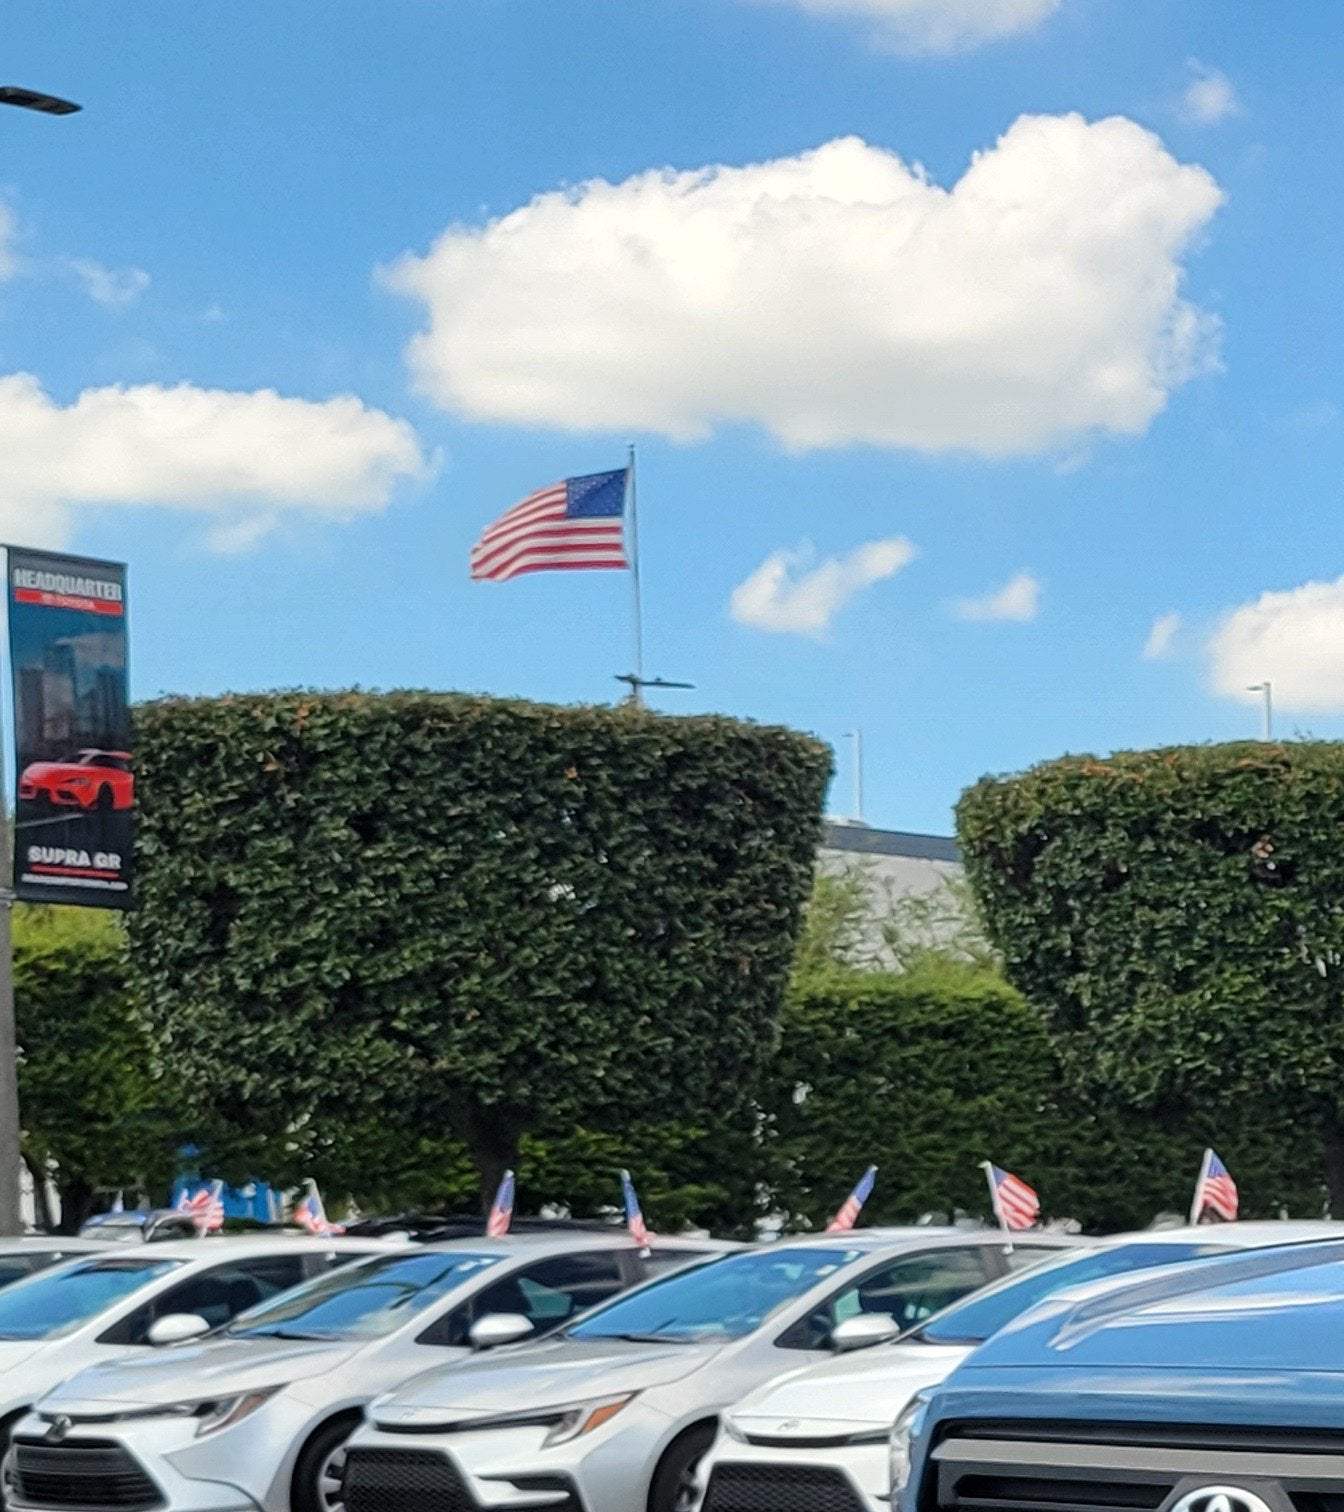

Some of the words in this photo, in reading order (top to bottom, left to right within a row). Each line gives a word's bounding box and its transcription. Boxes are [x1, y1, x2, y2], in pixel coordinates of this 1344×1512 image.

[13, 568, 122, 601] HEADQUARTER
[28, 845, 91, 867] SUPRA
[93, 851, 122, 870] GR
